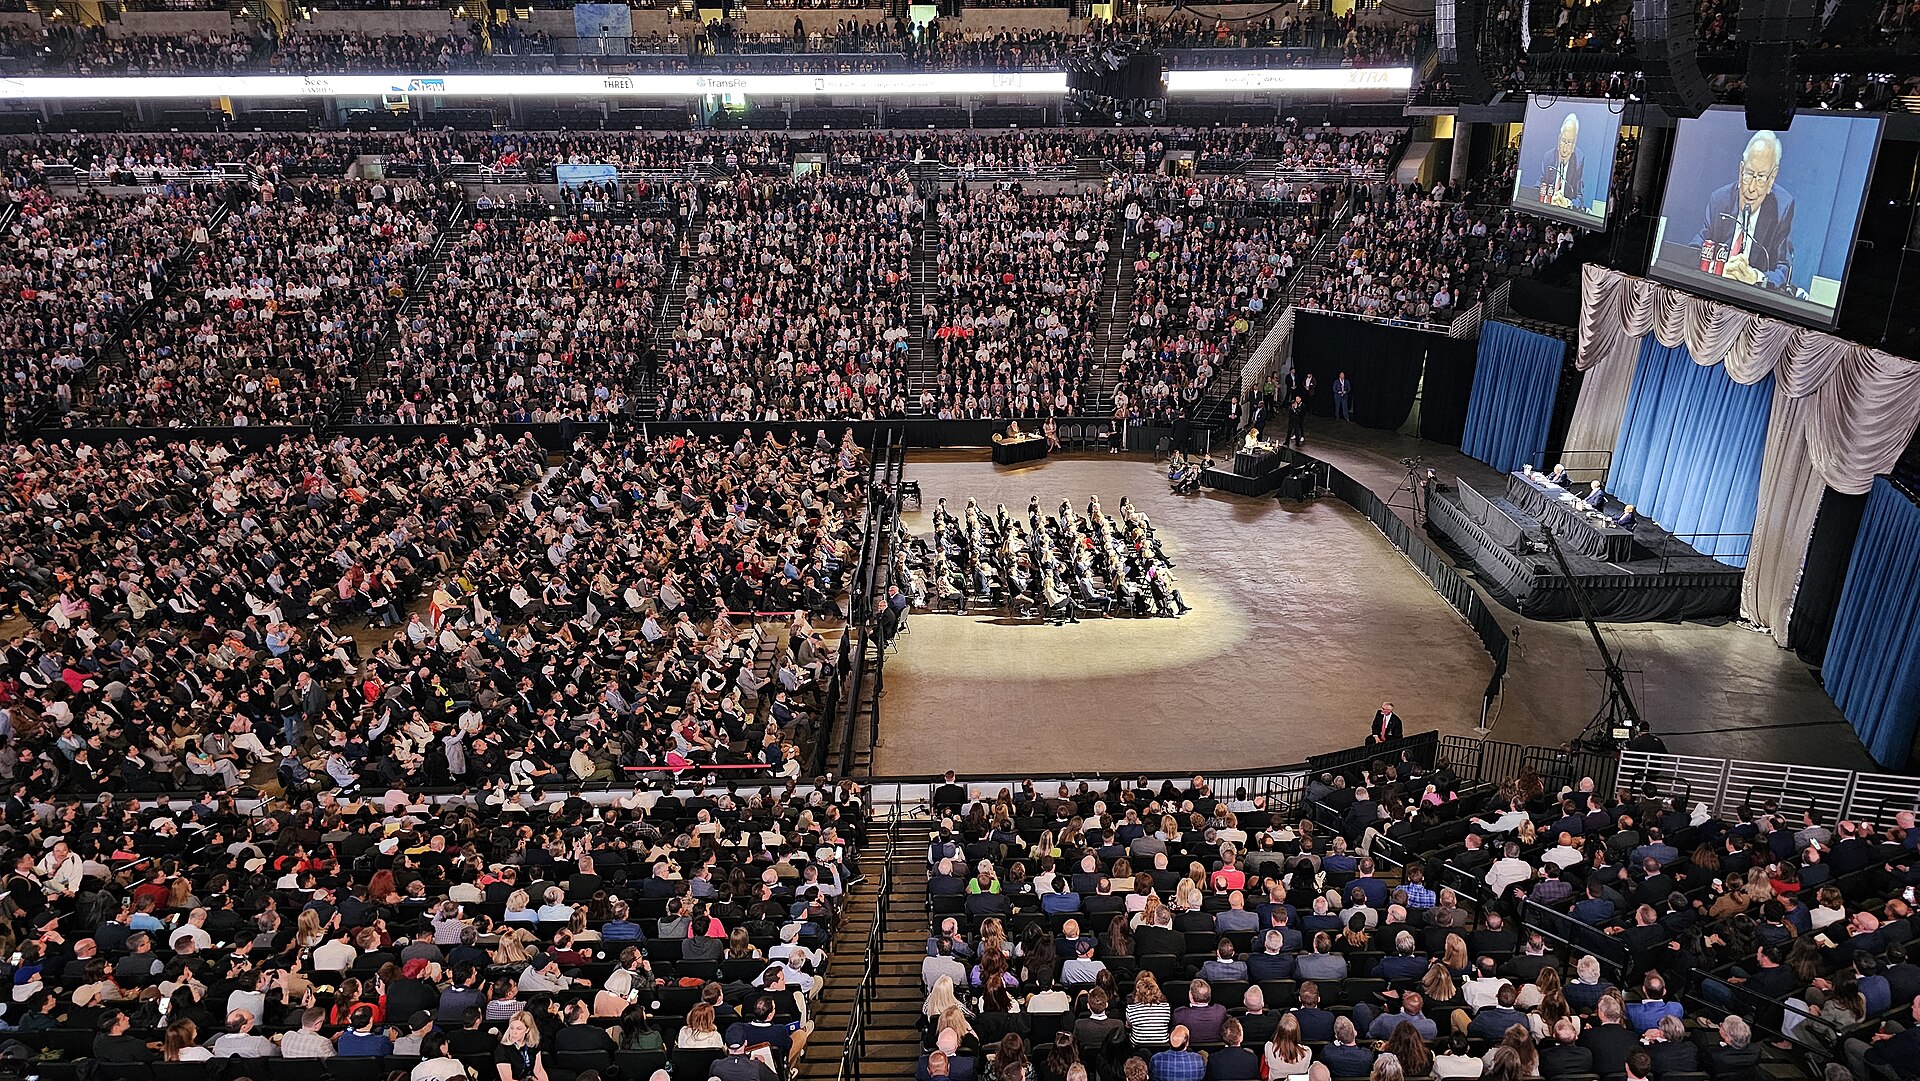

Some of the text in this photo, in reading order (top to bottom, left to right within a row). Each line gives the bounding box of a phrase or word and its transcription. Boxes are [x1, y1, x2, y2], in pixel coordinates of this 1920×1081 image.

[411, 79, 445, 91] Shaw
[603, 80, 629, 89] THREE
[707, 78, 747, 88] TransRe
